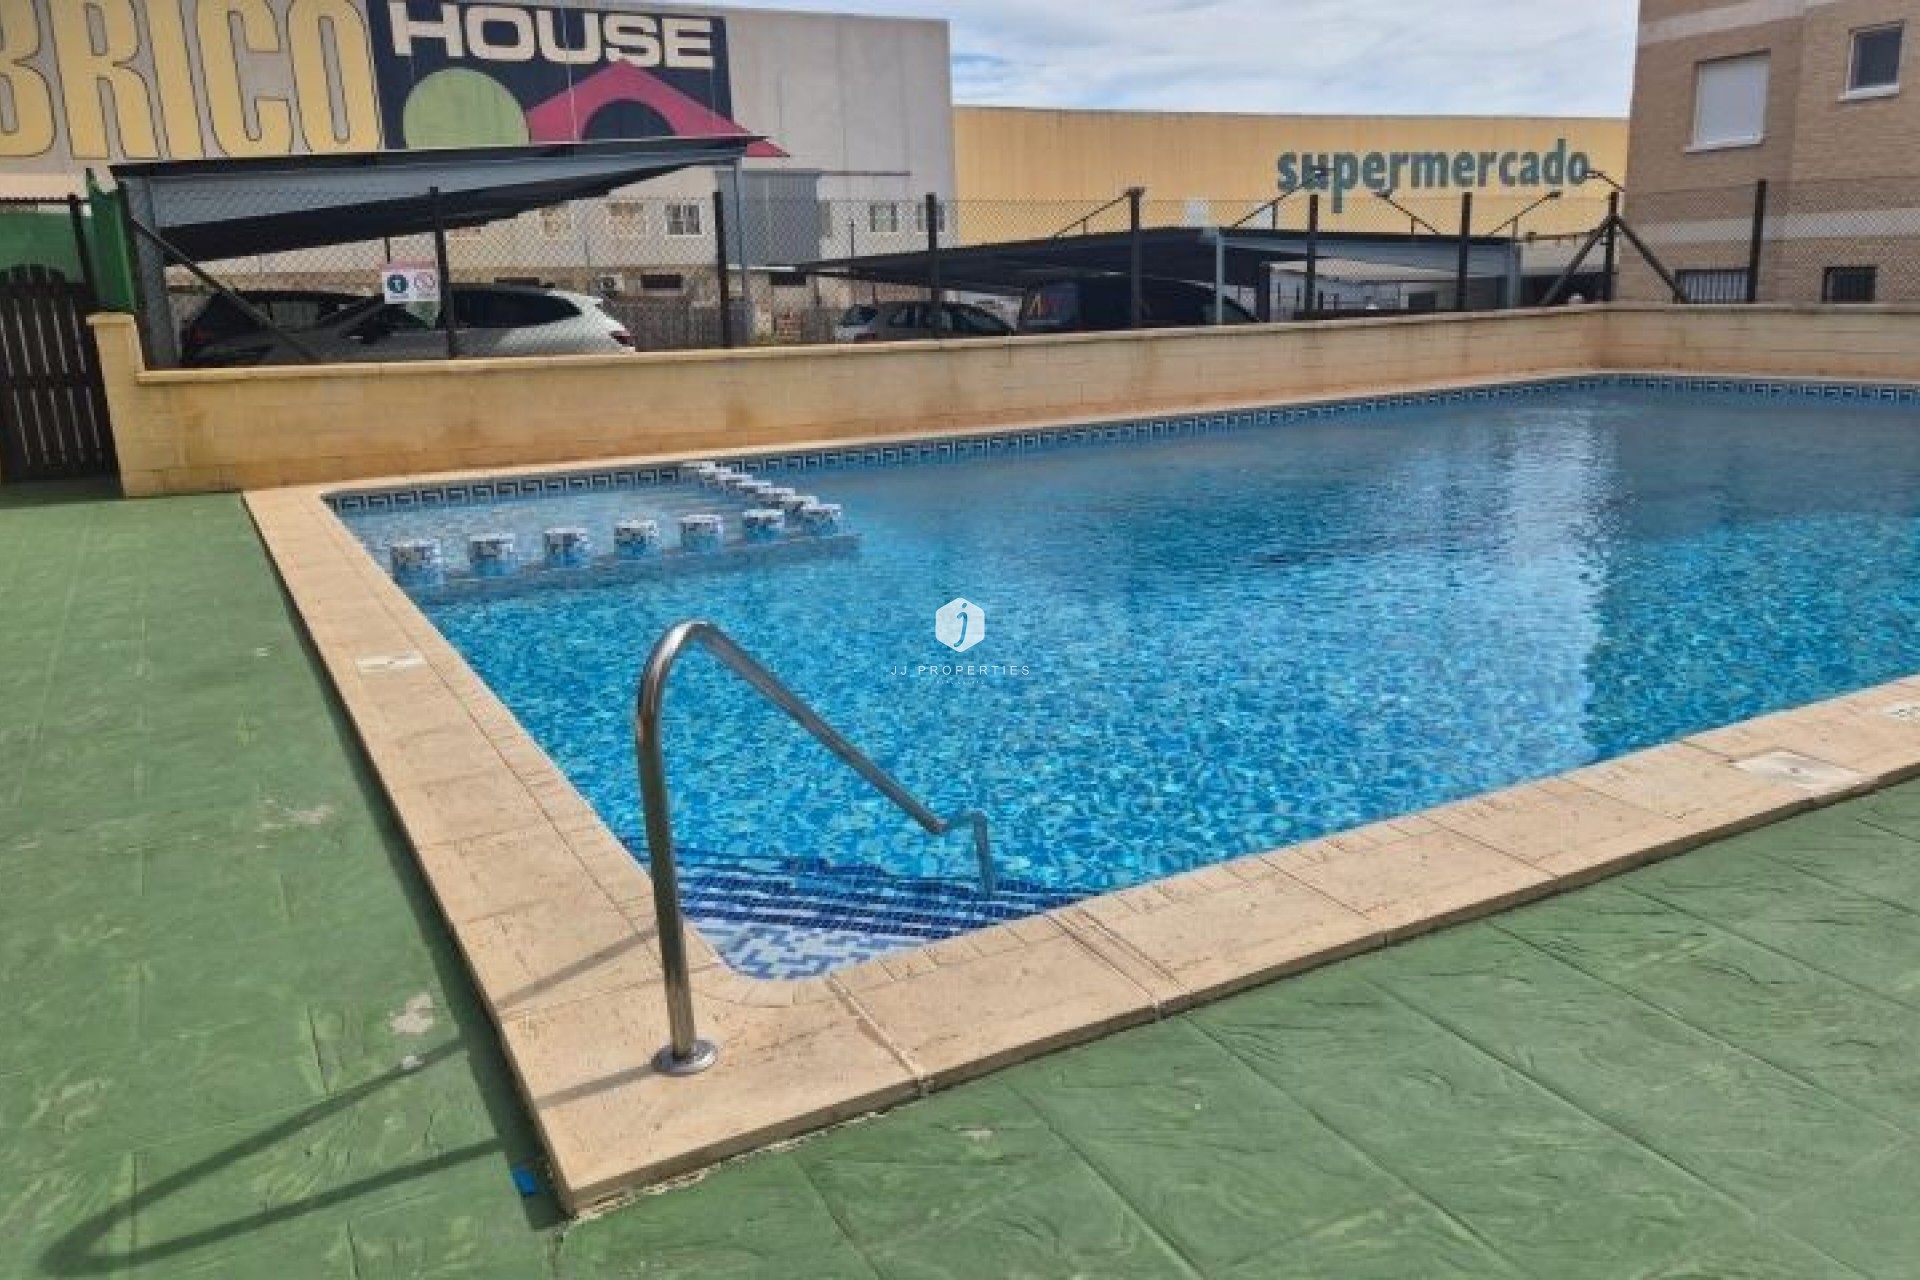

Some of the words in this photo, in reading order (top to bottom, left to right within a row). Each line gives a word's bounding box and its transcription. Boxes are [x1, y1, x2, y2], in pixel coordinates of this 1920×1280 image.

[389, 1, 714, 69] HOUSE
[0, 0, 384, 160] BRICO
[1276, 138, 1589, 213] supermercado
